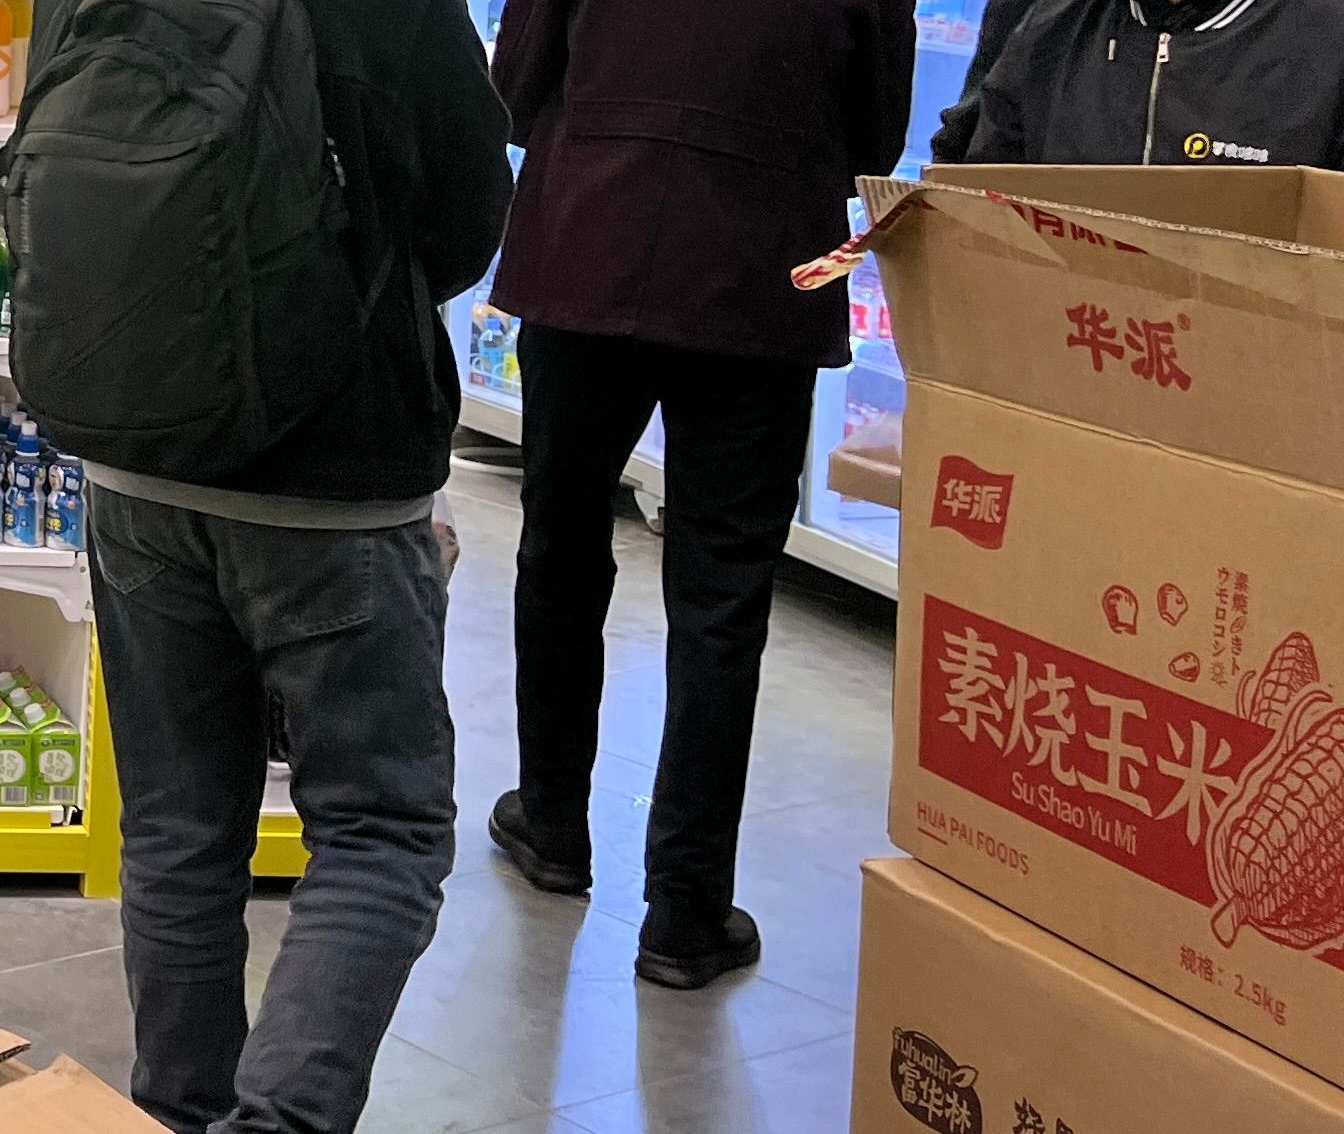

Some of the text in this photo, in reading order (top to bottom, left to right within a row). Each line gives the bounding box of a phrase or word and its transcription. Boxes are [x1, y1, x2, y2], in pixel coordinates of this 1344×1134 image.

[1064, 302, 1193, 393] 华派
[941, 477, 1004, 524] 华派
[936, 626, 1241, 847] 素烧玉米
[916, 801, 1030, 877] HUA PAI FOODS
[1011, 771, 1138, 857] Su Shao Yu Mi
[1232, 971, 1289, 1026] 2.5kg
[897, 1059, 972, 1134] 富华林
